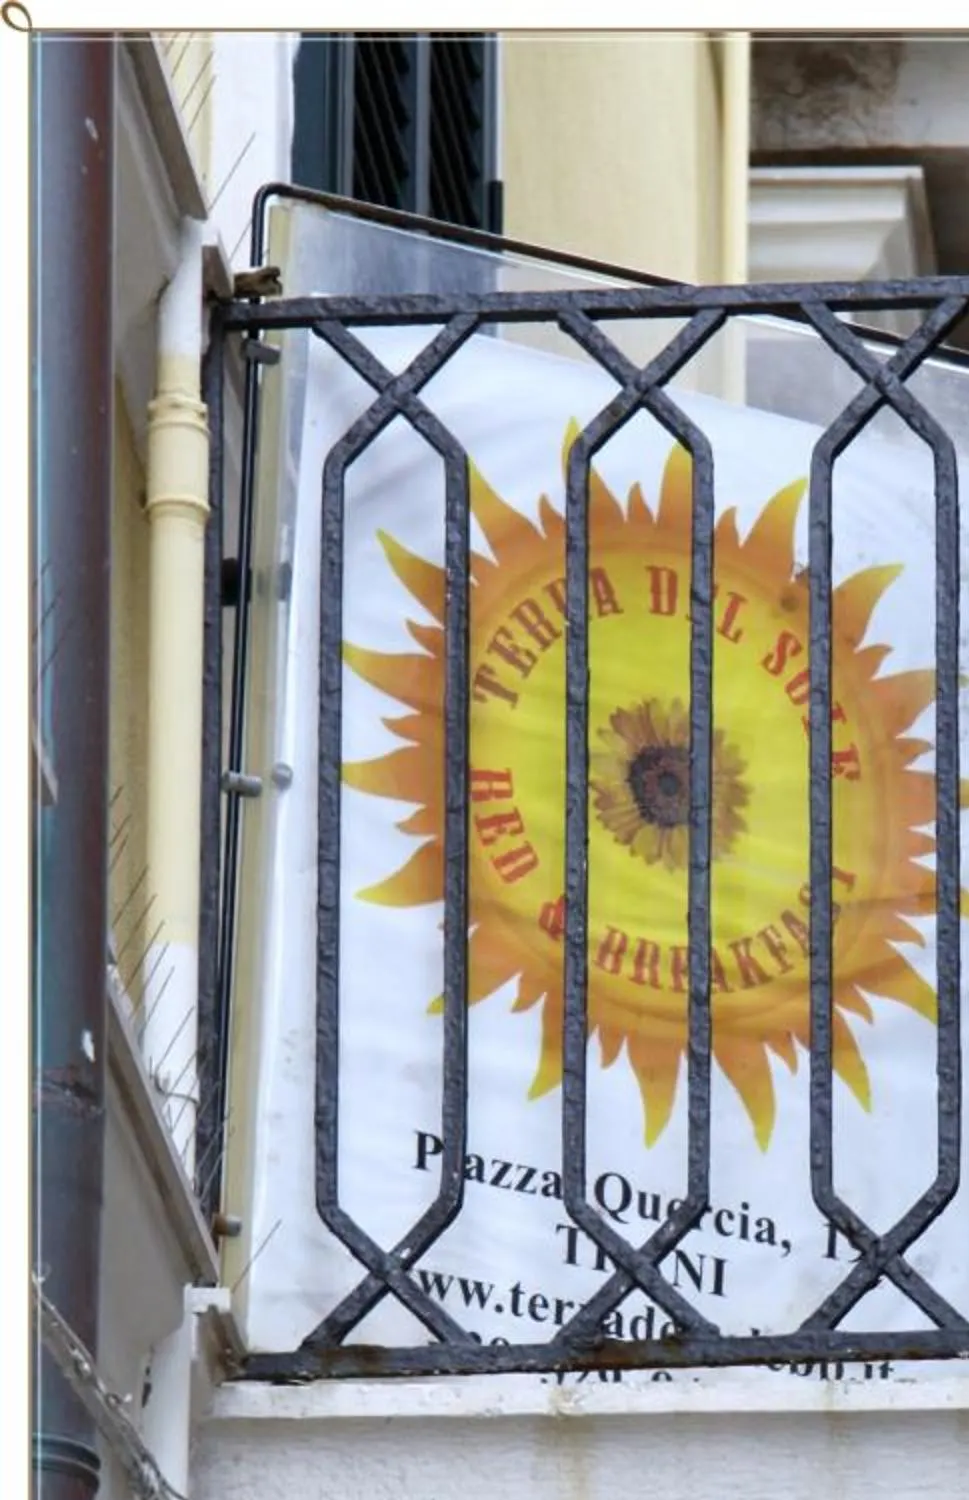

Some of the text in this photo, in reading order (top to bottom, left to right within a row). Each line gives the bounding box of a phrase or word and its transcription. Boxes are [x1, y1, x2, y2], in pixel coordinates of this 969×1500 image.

[645, 566, 747, 644] DL
[469, 768, 540, 884] BED
[412, 1131, 565, 1200] Pazza
[556, 1223, 728, 1298] TNI
